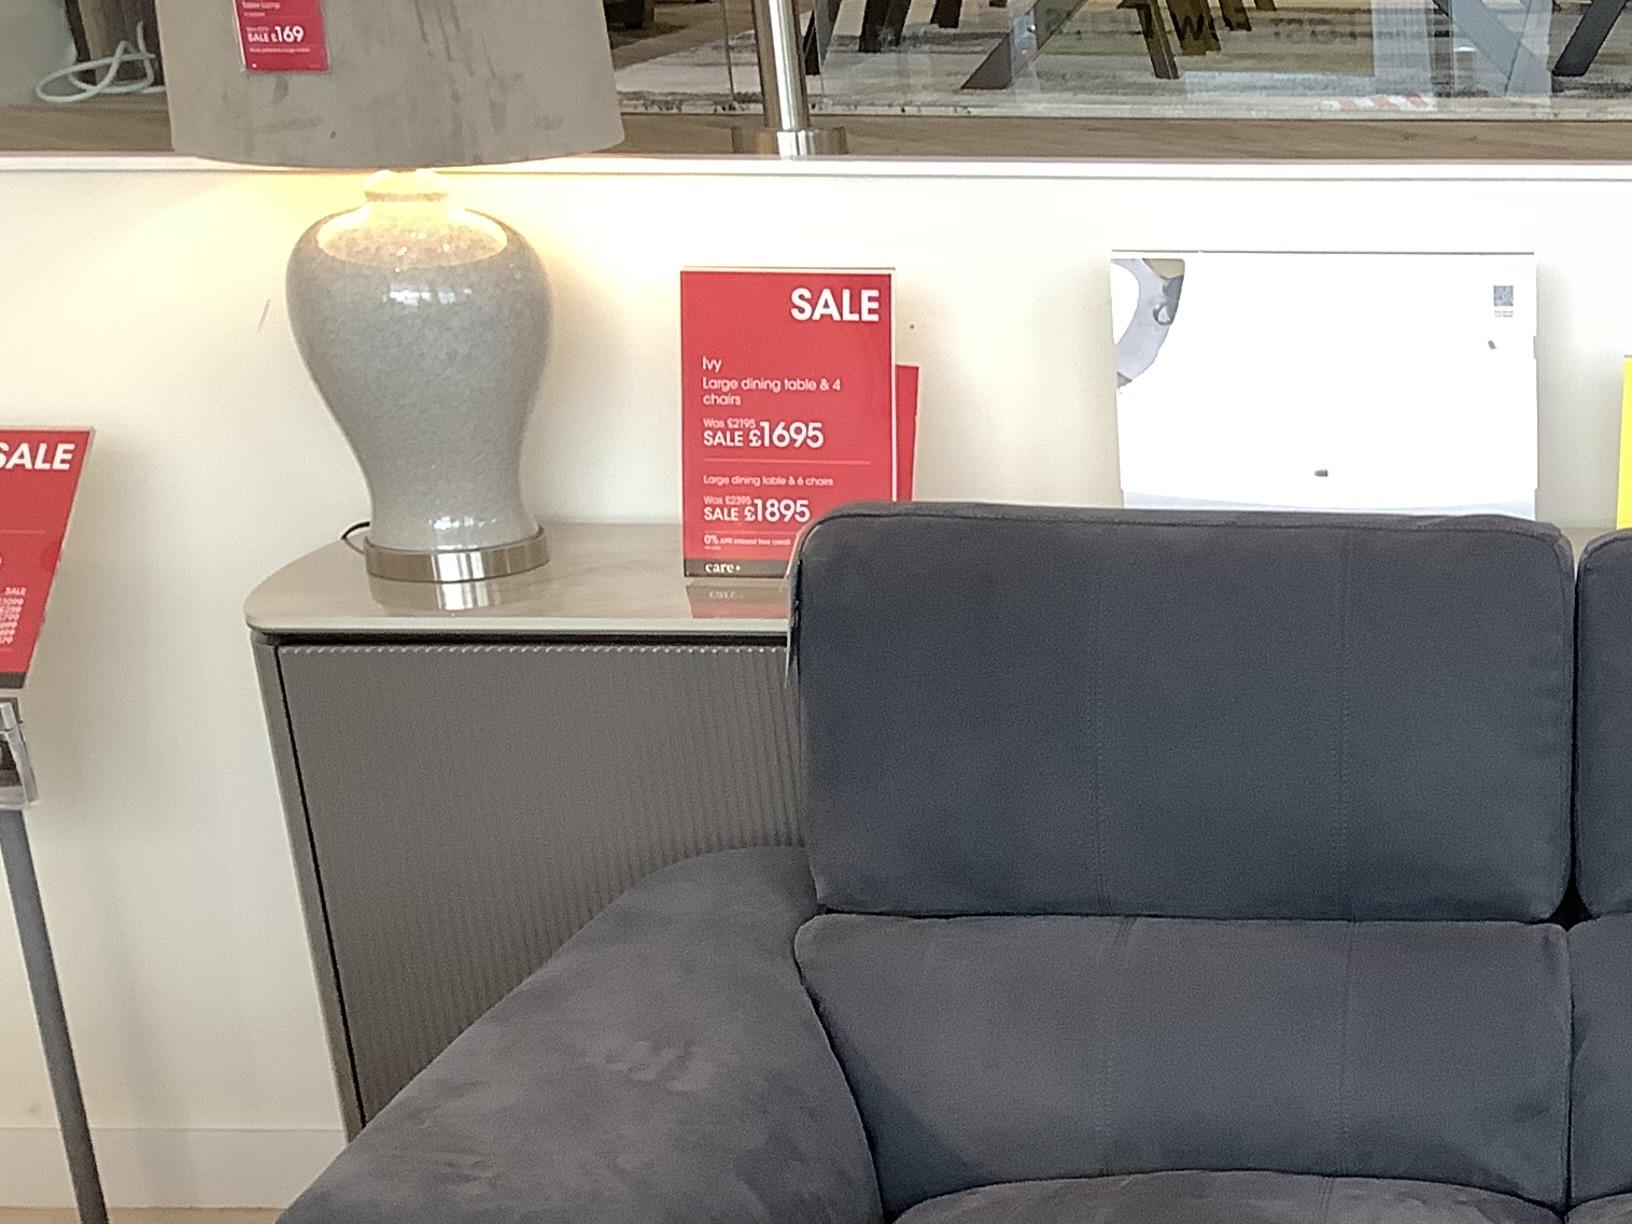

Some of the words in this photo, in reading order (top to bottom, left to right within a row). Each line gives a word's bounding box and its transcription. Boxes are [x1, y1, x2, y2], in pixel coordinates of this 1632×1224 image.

[248, 33, 269, 42] SALE
[271, 25, 304, 42] £169
[791, 288, 880, 322] SALE
[703, 356, 722, 373] Ivy
[703, 377, 738, 392] Large
[741, 378, 781, 393] dining
[784, 378, 817, 391] table
[820, 379, 829, 391] &
[832, 379, 841, 391] 4
[703, 393, 742, 406] chairs
[704, 418, 724, 428] Was
[704, 431, 743, 447] SALE
[749, 421, 824, 448] £1695
[704, 475, 729, 487] Large
[731, 476, 760, 487] dining
[763, 476, 786, 486] table
[805, 477, 834, 487] chairs
[704, 507, 738, 521] SALE
[744, 499, 811, 523] £1895
